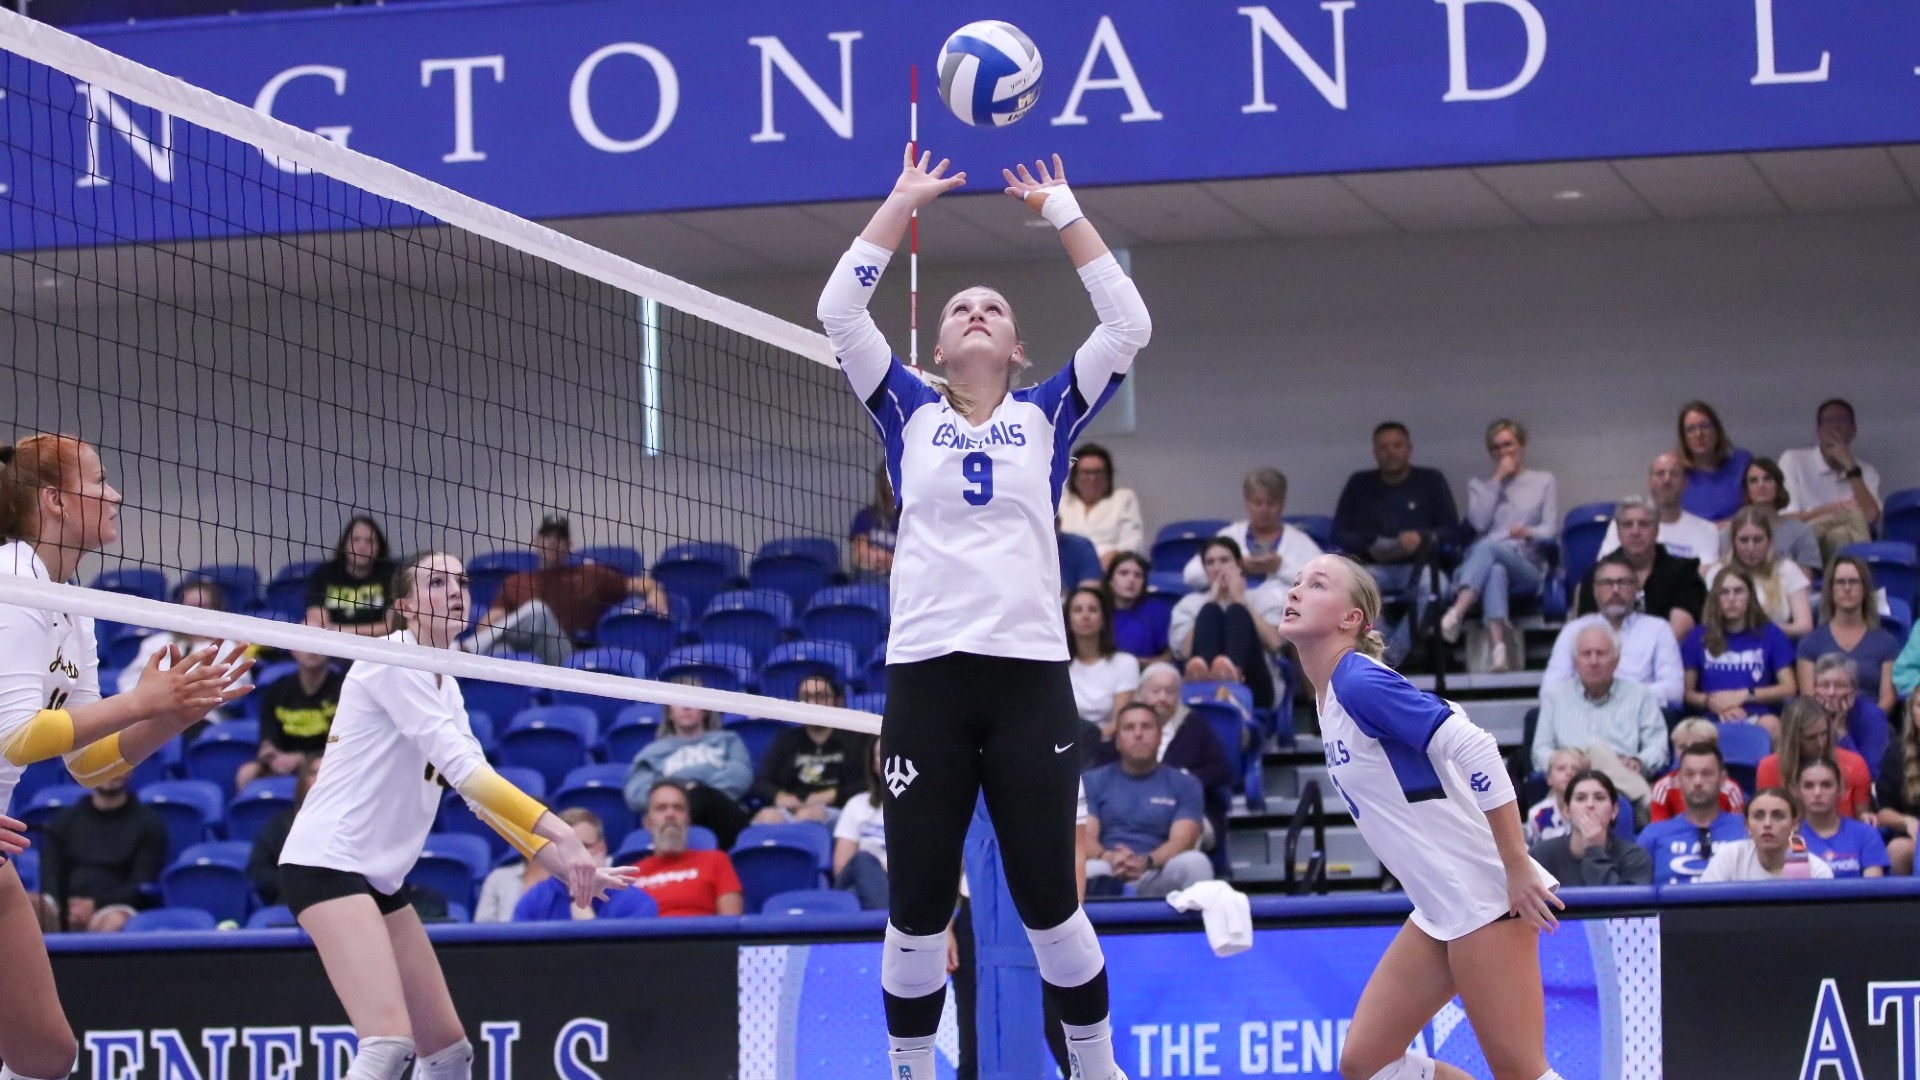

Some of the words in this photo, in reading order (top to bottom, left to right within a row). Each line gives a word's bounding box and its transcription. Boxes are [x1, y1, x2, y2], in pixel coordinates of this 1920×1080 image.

[0, 31, 864, 193] NGTON
[1051, 0, 1547, 126] AND
[963, 452, 993, 505] 9
[1131, 1022, 1221, 1078] THE
